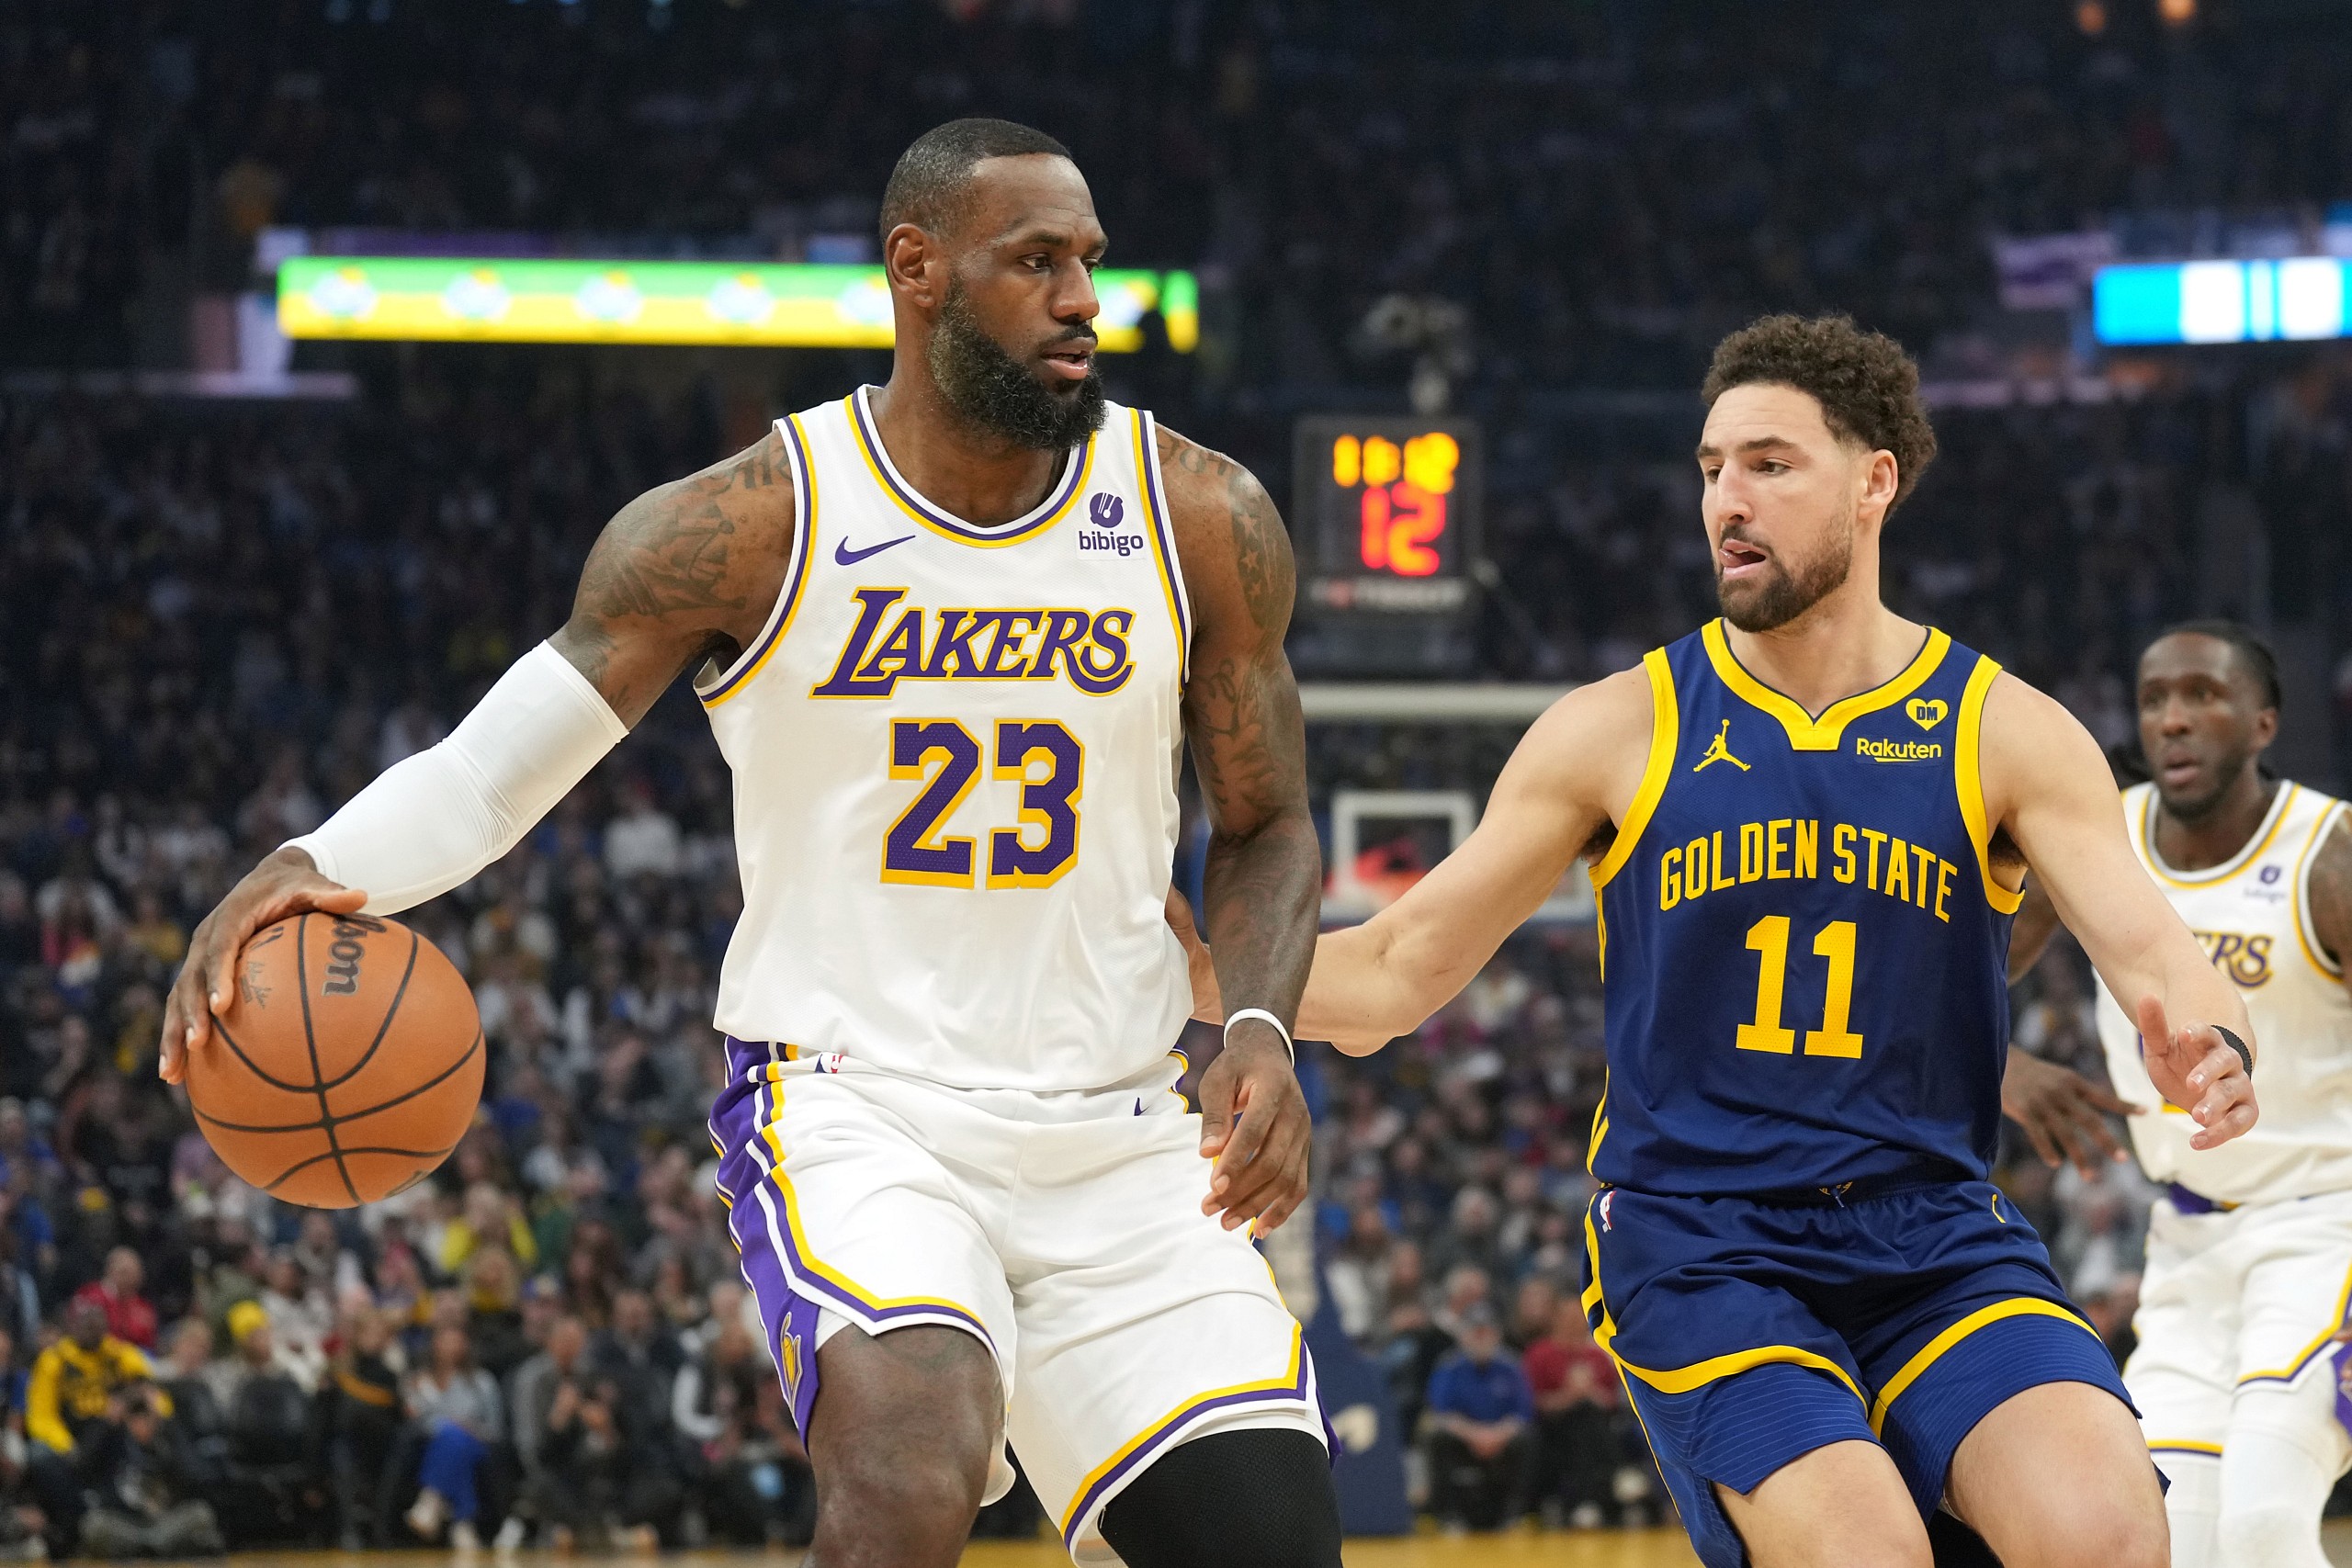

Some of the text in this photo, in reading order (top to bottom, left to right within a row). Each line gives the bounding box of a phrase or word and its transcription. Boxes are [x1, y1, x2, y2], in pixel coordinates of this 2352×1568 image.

[1079, 530, 1144, 557] bibigo
[1362, 482, 1445, 576] 12
[808, 586, 1137, 700] LAKERS
[1856, 738, 1942, 760] Rakuten
[1917, 705, 1938, 721] DM
[880, 717, 1085, 890] 23
[1659, 818, 1959, 924] GOLDEN STATE
[1736, 914, 1864, 1059] 11
